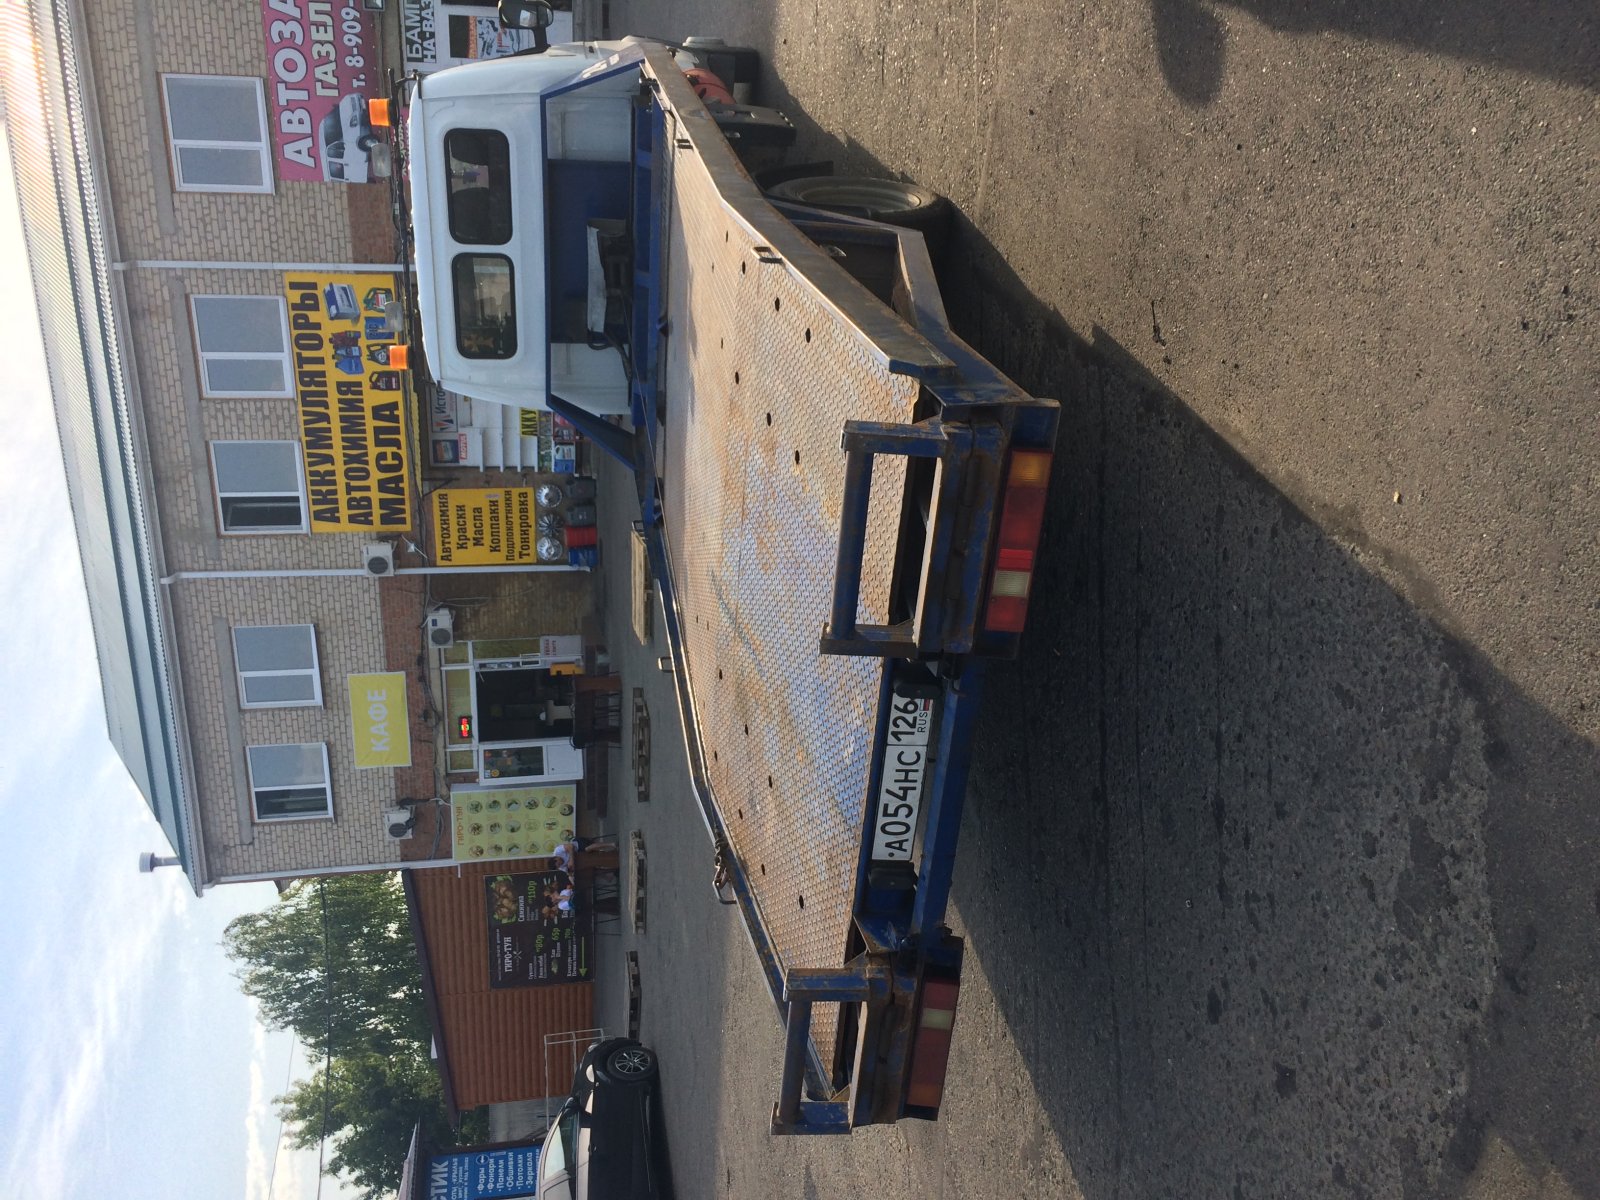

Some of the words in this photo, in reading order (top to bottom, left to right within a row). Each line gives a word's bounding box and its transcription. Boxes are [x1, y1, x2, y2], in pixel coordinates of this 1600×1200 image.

[288, 281, 341, 524] АККУМУЛЯТОРЫ
[335, 380, 374, 526] АВТОХИМИЯ
[371, 400, 407, 526] МАСЛА
[438, 493, 452, 562] Автохимия
[456, 504, 470, 550] Краски
[472, 506, 485, 547] Масла
[489, 499, 501, 553] Колпаки
[504, 489, 516, 561] Подлокотники
[518, 491, 532, 559] Тонировка
[367, 689, 390, 752] КАФЕ
[890, 698, 918, 742] 126
[917, 711, 928, 733] RUS
[880, 750, 921, 853] А054НС
[455, 806, 465, 846] ГИРО-ТУН
[503, 936, 513, 972] ГИРО-ТУН
[477, 1167, 486, 1191] Фары
[487, 1158, 496, 1189] Фонари
[497, 1159, 505, 1188] Панели
[506, 1152, 514, 1187] Обшивки
[525, 1152, 535, 1185] Зеркала
